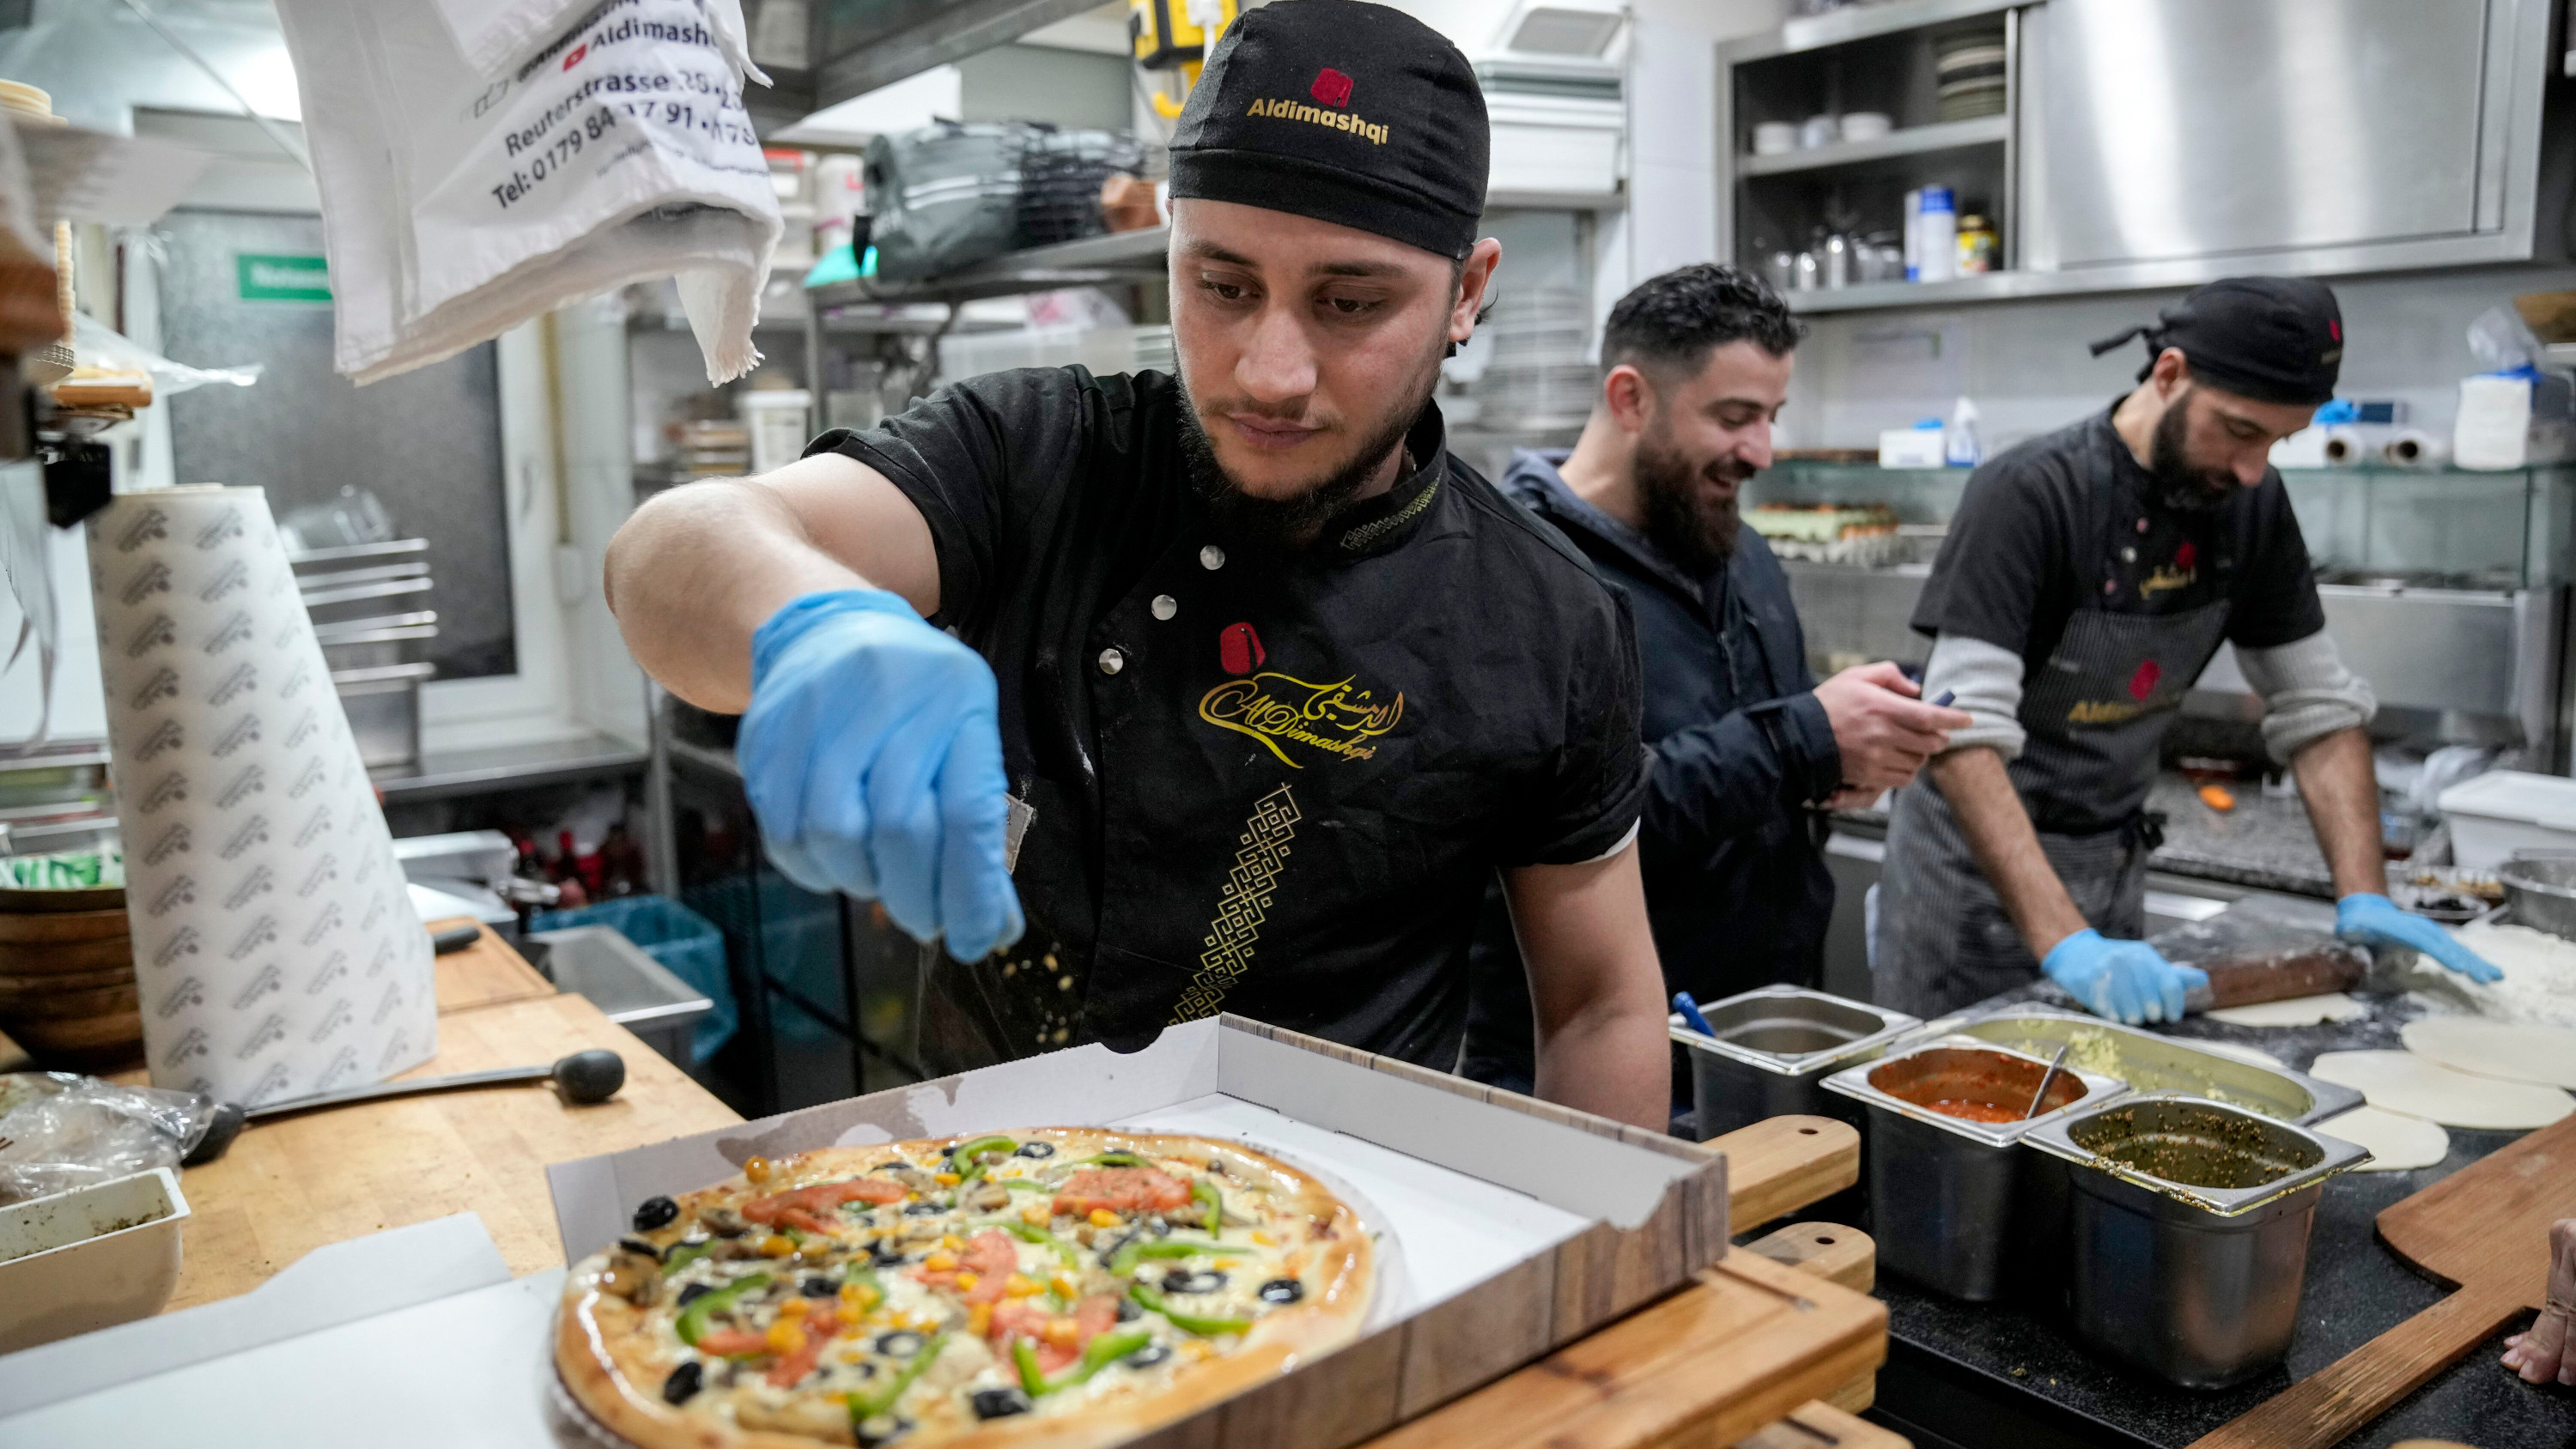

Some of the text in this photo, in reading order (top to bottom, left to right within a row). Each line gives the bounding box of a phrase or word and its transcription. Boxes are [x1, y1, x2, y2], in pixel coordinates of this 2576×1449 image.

[491, 170, 532, 210] Tel:
[532, 129, 583, 182] 0179
[666, 103, 692, 130] 91
[504, 72, 670, 157] Reuterstrasse
[1246, 98, 1389, 146] Aldimashqi
